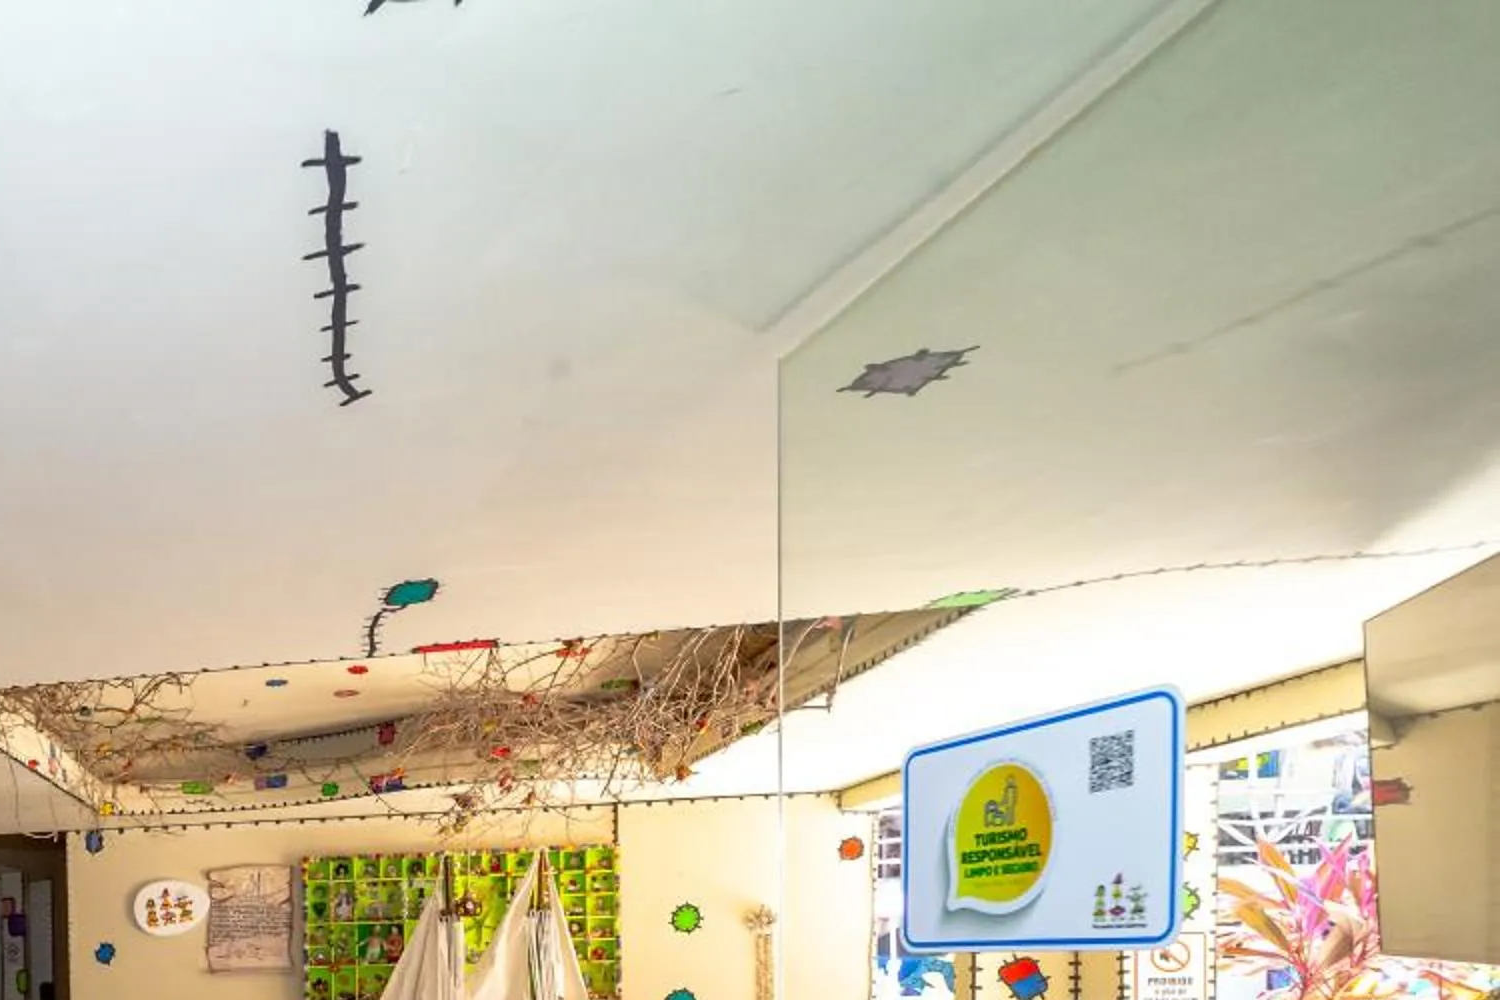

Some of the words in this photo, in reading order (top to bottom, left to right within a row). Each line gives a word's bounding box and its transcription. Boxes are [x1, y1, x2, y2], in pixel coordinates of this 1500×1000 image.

[973, 827, 1028, 846] TURISMO
[961, 840, 1042, 864] RESPONSÁVEL
[964, 866, 992, 878] LIMPO
